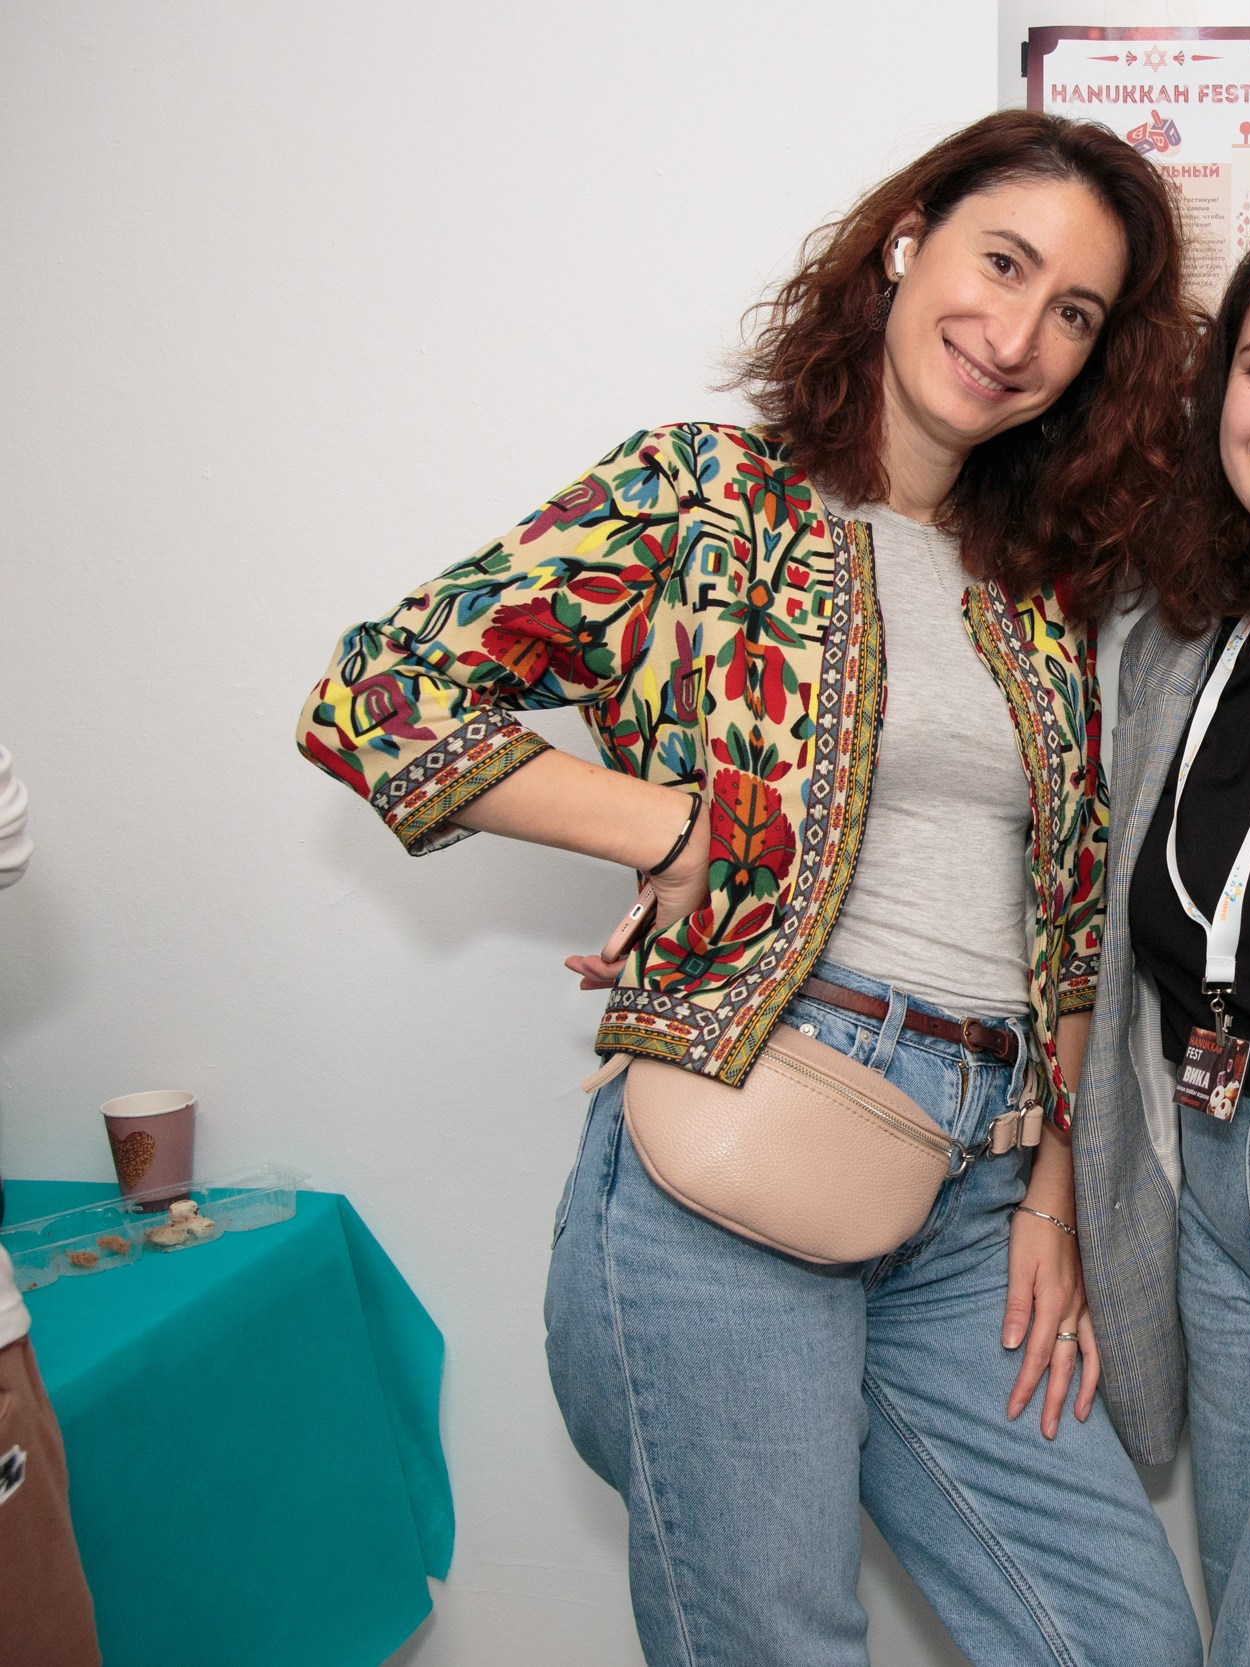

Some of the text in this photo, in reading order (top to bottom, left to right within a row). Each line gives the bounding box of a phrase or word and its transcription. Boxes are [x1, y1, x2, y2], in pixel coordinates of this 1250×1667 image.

[1051, 83, 1190, 104] HANUKKAH
[1161, 163, 1220, 178] ЛЬНЫЙ
[1186, 1046, 1203, 1060] FEST
[1182, 1066, 1210, 1089] ВИКА
